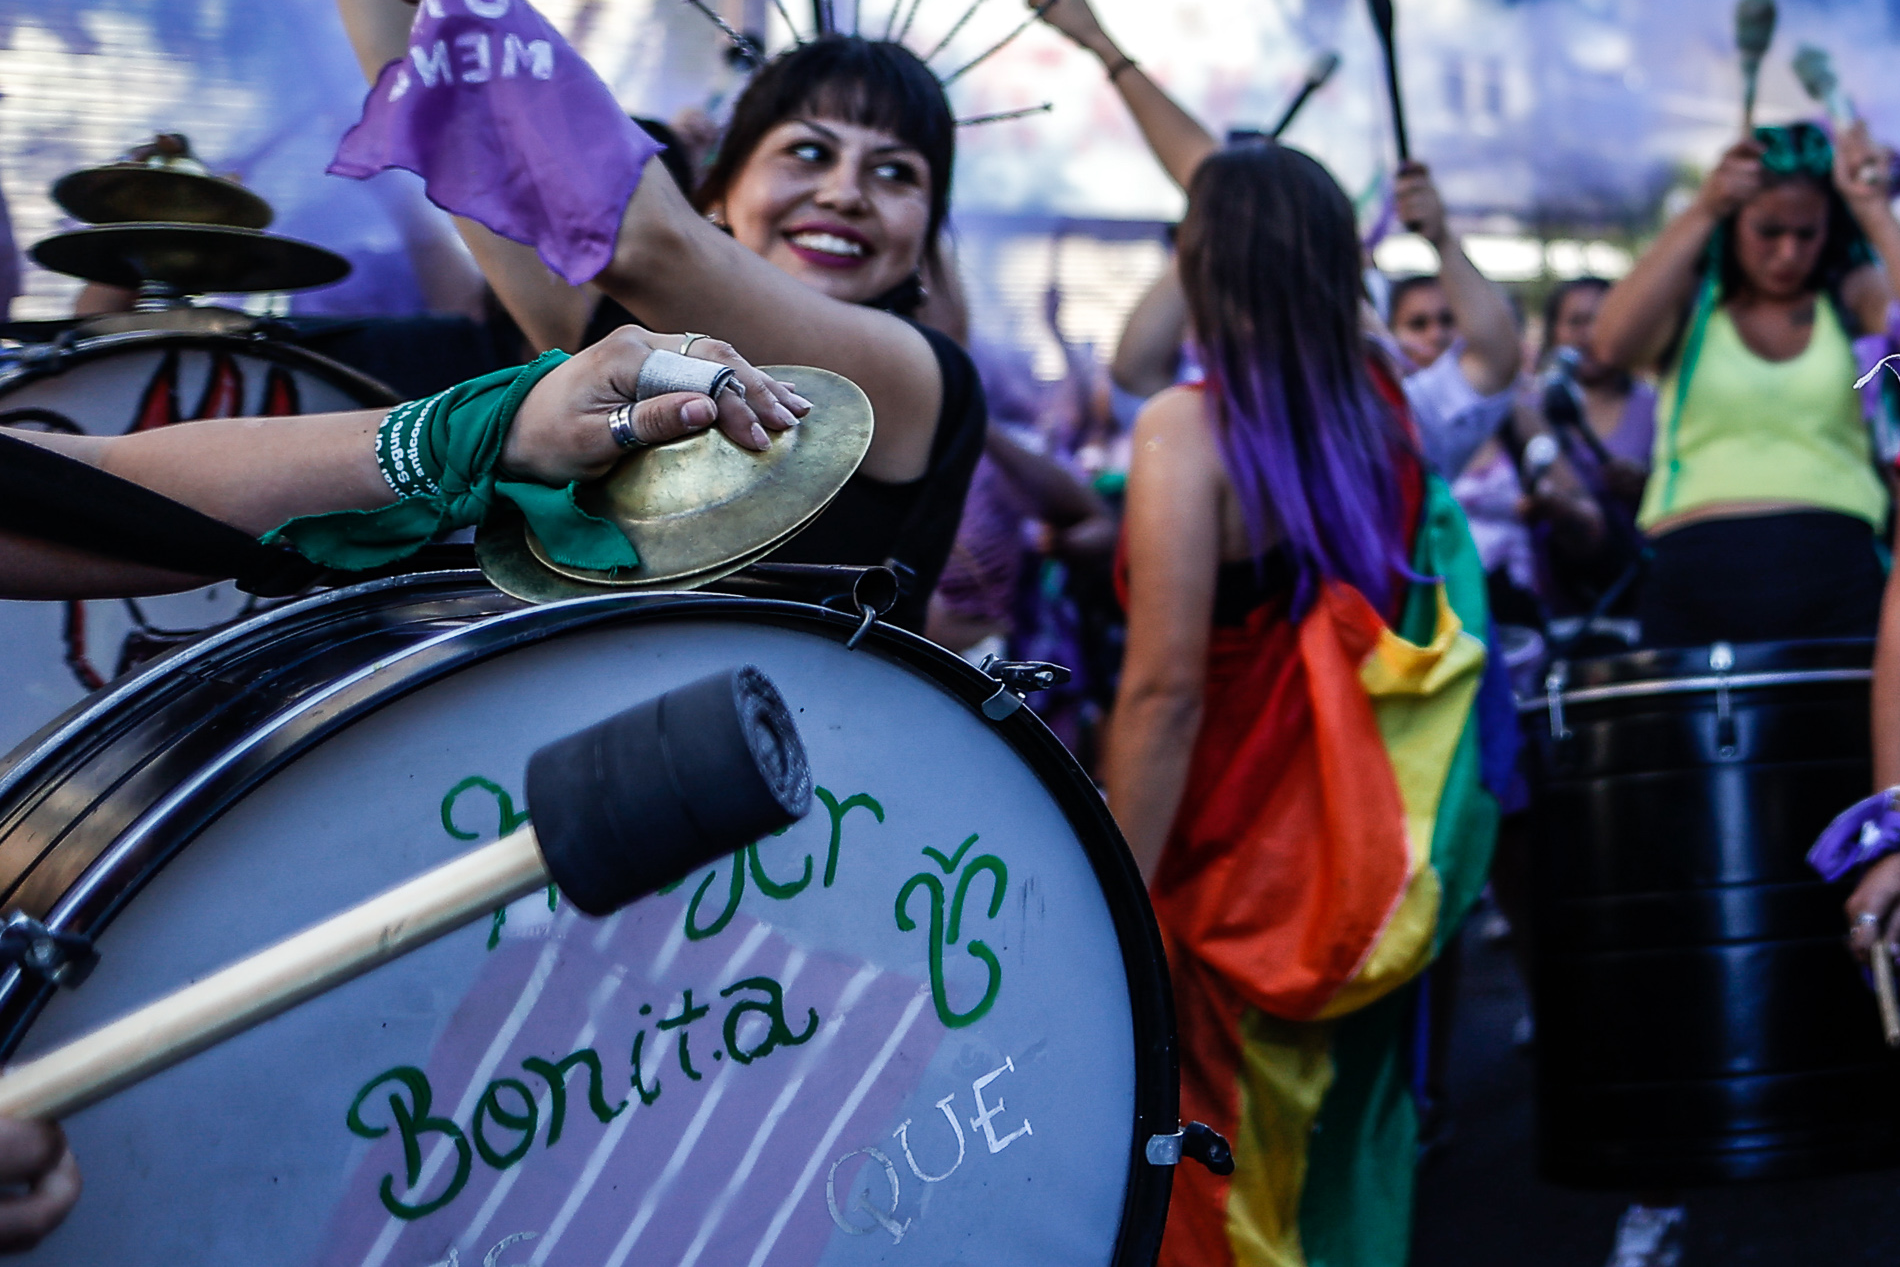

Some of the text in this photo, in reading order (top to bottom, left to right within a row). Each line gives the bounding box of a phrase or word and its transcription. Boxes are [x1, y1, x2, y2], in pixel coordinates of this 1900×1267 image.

[390, 421, 410, 483] Seguro
[348, 976, 818, 1219] Bonita
[826, 1055, 1033, 1245] QUE
